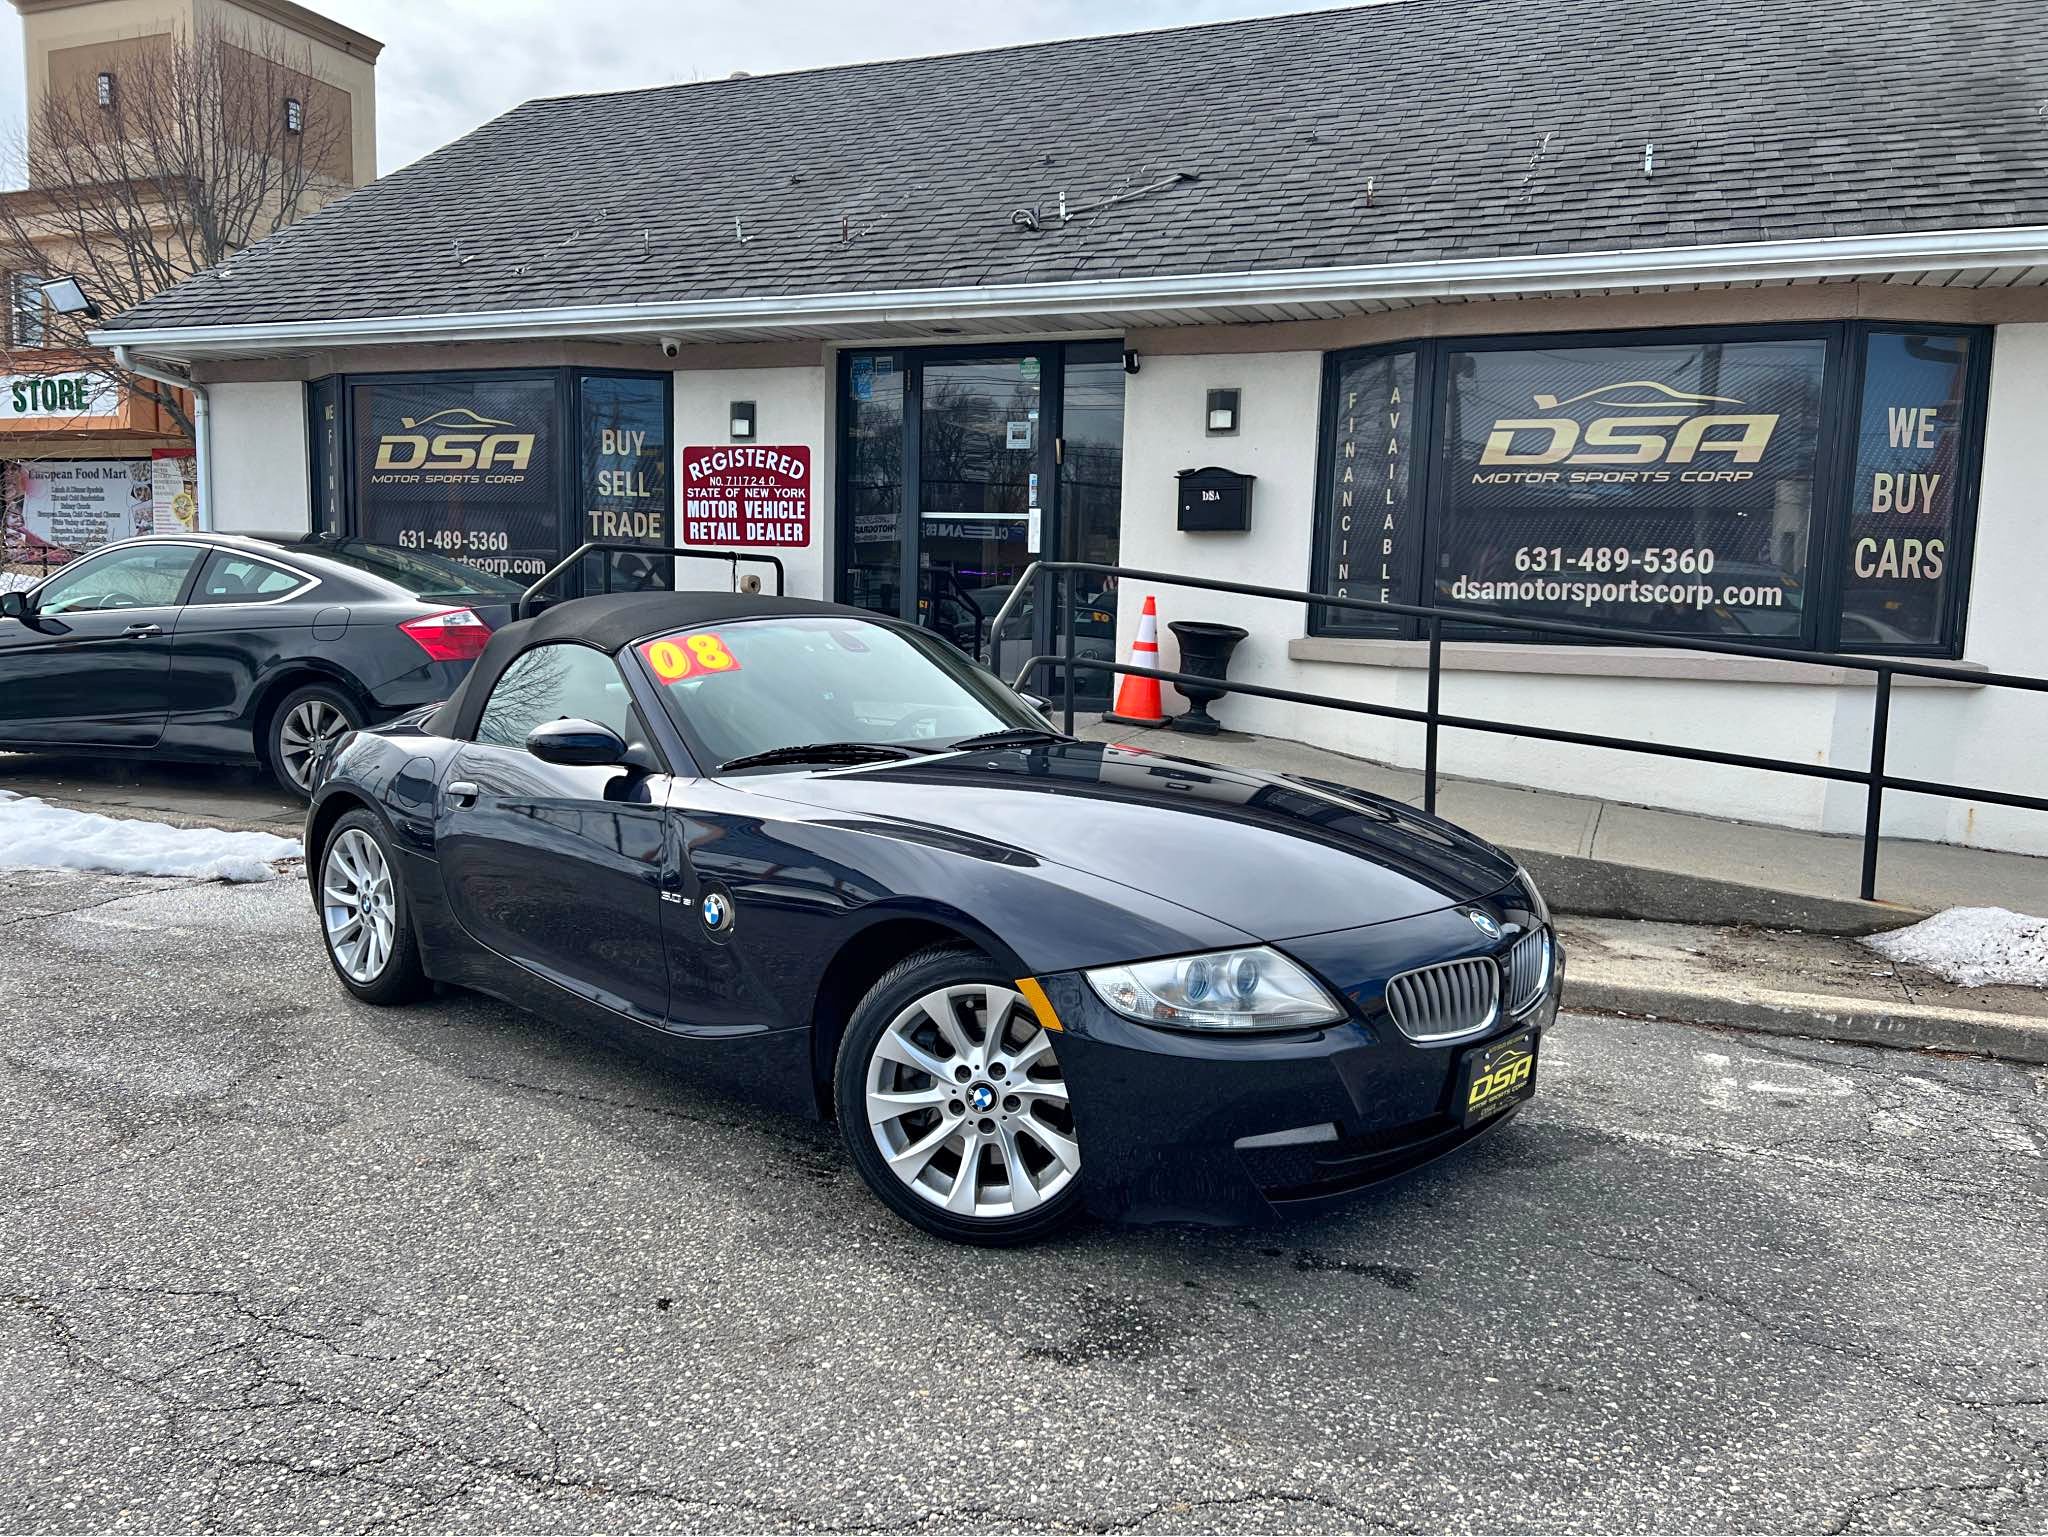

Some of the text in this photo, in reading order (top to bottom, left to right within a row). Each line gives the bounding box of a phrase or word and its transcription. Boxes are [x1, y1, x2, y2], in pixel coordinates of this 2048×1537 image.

[12, 378, 90, 412] STORE
[1478, 414, 1780, 465] DSA
[1888, 407, 1937, 449] WE
[374, 434, 536, 470] DSA
[602, 429, 646, 456] BUY
[28, 467, 127, 481] European Food Mart
[688, 448, 805, 481] REGISTERED
[1471, 470, 1754, 484] MOTOR SPORTS CORP
[371, 474, 525, 484] MOTOR SPORTS CORP
[598, 469, 651, 497] SELL
[687, 488, 806, 498] STATE OF NEW YORK
[709, 476, 723, 486] NO.
[1872, 472, 1941, 514] BUY
[1202, 490, 1220, 501] DSA
[1338, 392, 1357, 598] FINANCING
[1381, 387, 1401, 604] AVAILABLE
[687, 500, 806, 519] MOTOR VEHICLE
[588, 510, 661, 538] TRADE
[690, 522, 803, 541] RETAIL DEALER
[399, 530, 508, 550] 631-489-5360
[1514, 546, 1714, 574] 631-489-5360
[1854, 537, 1945, 580] CARS
[1451, 575, 1782, 610] dsamotorsportscorp.com
[649, 634, 733, 679] 08
[1469, 1054, 1533, 1105] DSA
